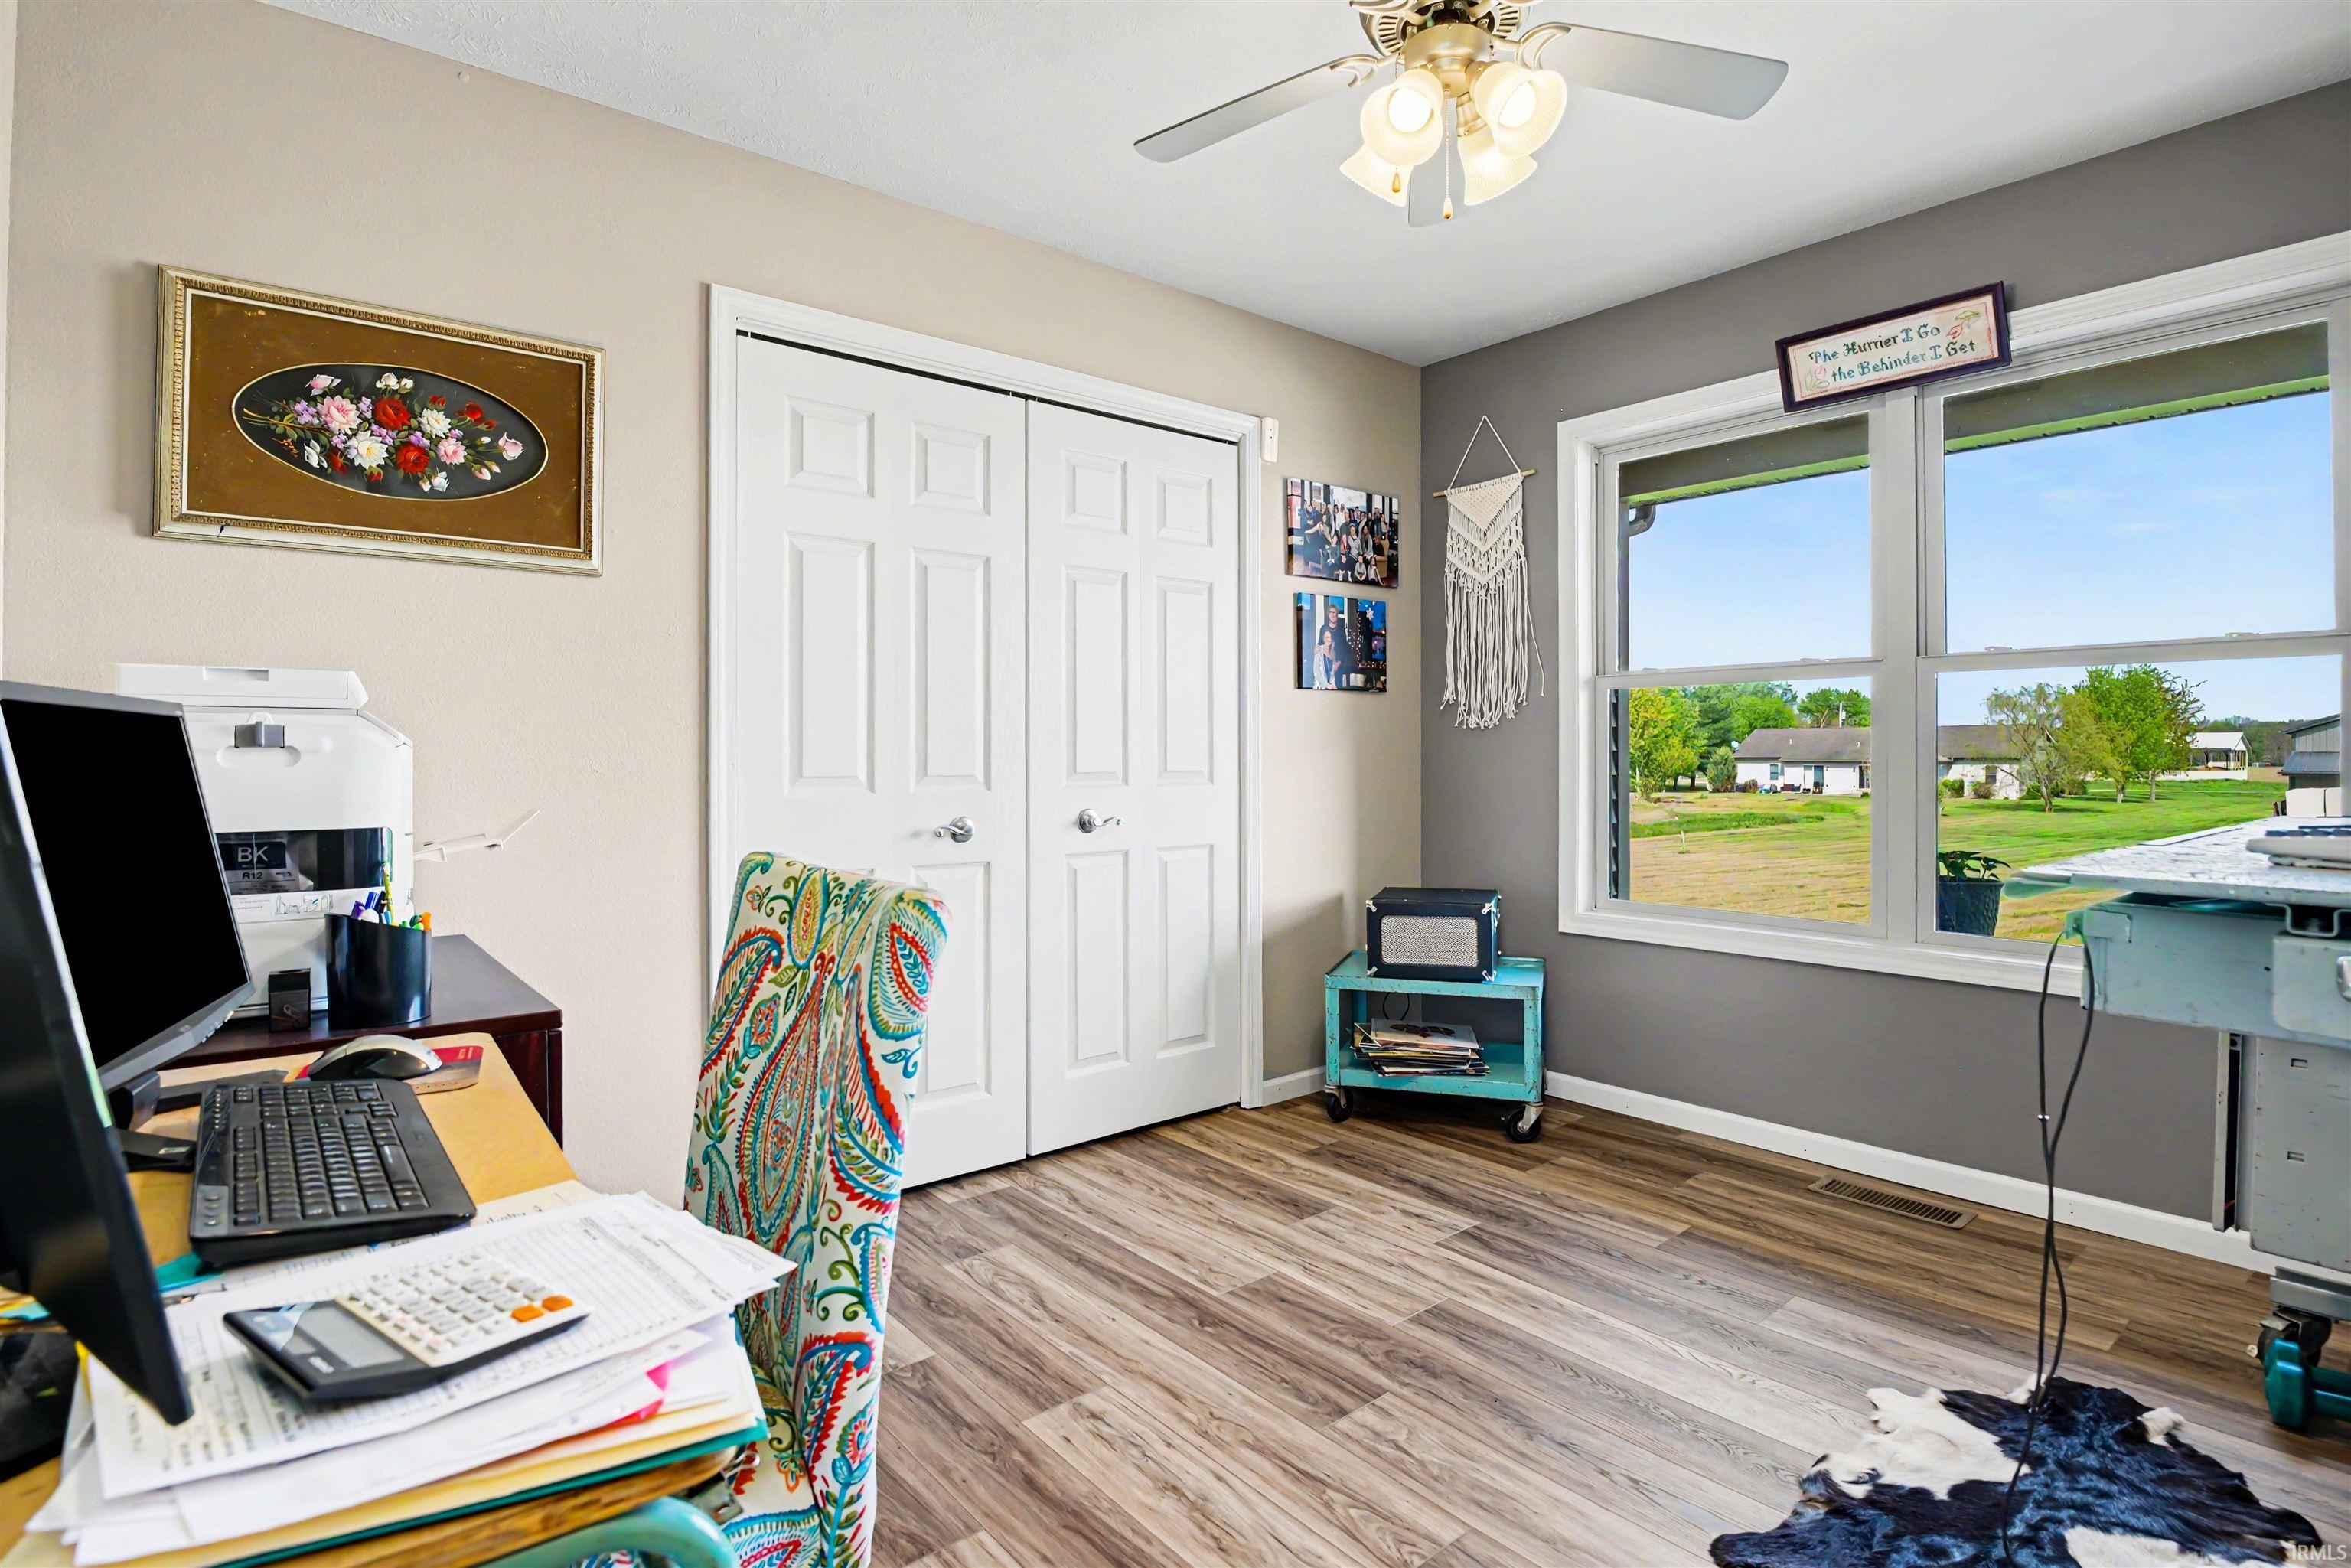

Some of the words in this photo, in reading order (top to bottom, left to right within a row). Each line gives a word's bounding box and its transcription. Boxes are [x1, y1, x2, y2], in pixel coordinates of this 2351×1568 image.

[1808, 349, 1840, 364] The
[1843, 334, 1899, 357] Hurrier
[1900, 327, 1914, 343] I
[1917, 323, 1941, 339] Go
[1831, 367, 1855, 382] the
[1857, 351, 1926, 377] Behinder
[1929, 344, 1942, 360] I
[1946, 339, 1975, 357] Get
[237, 846, 269, 862] BK
